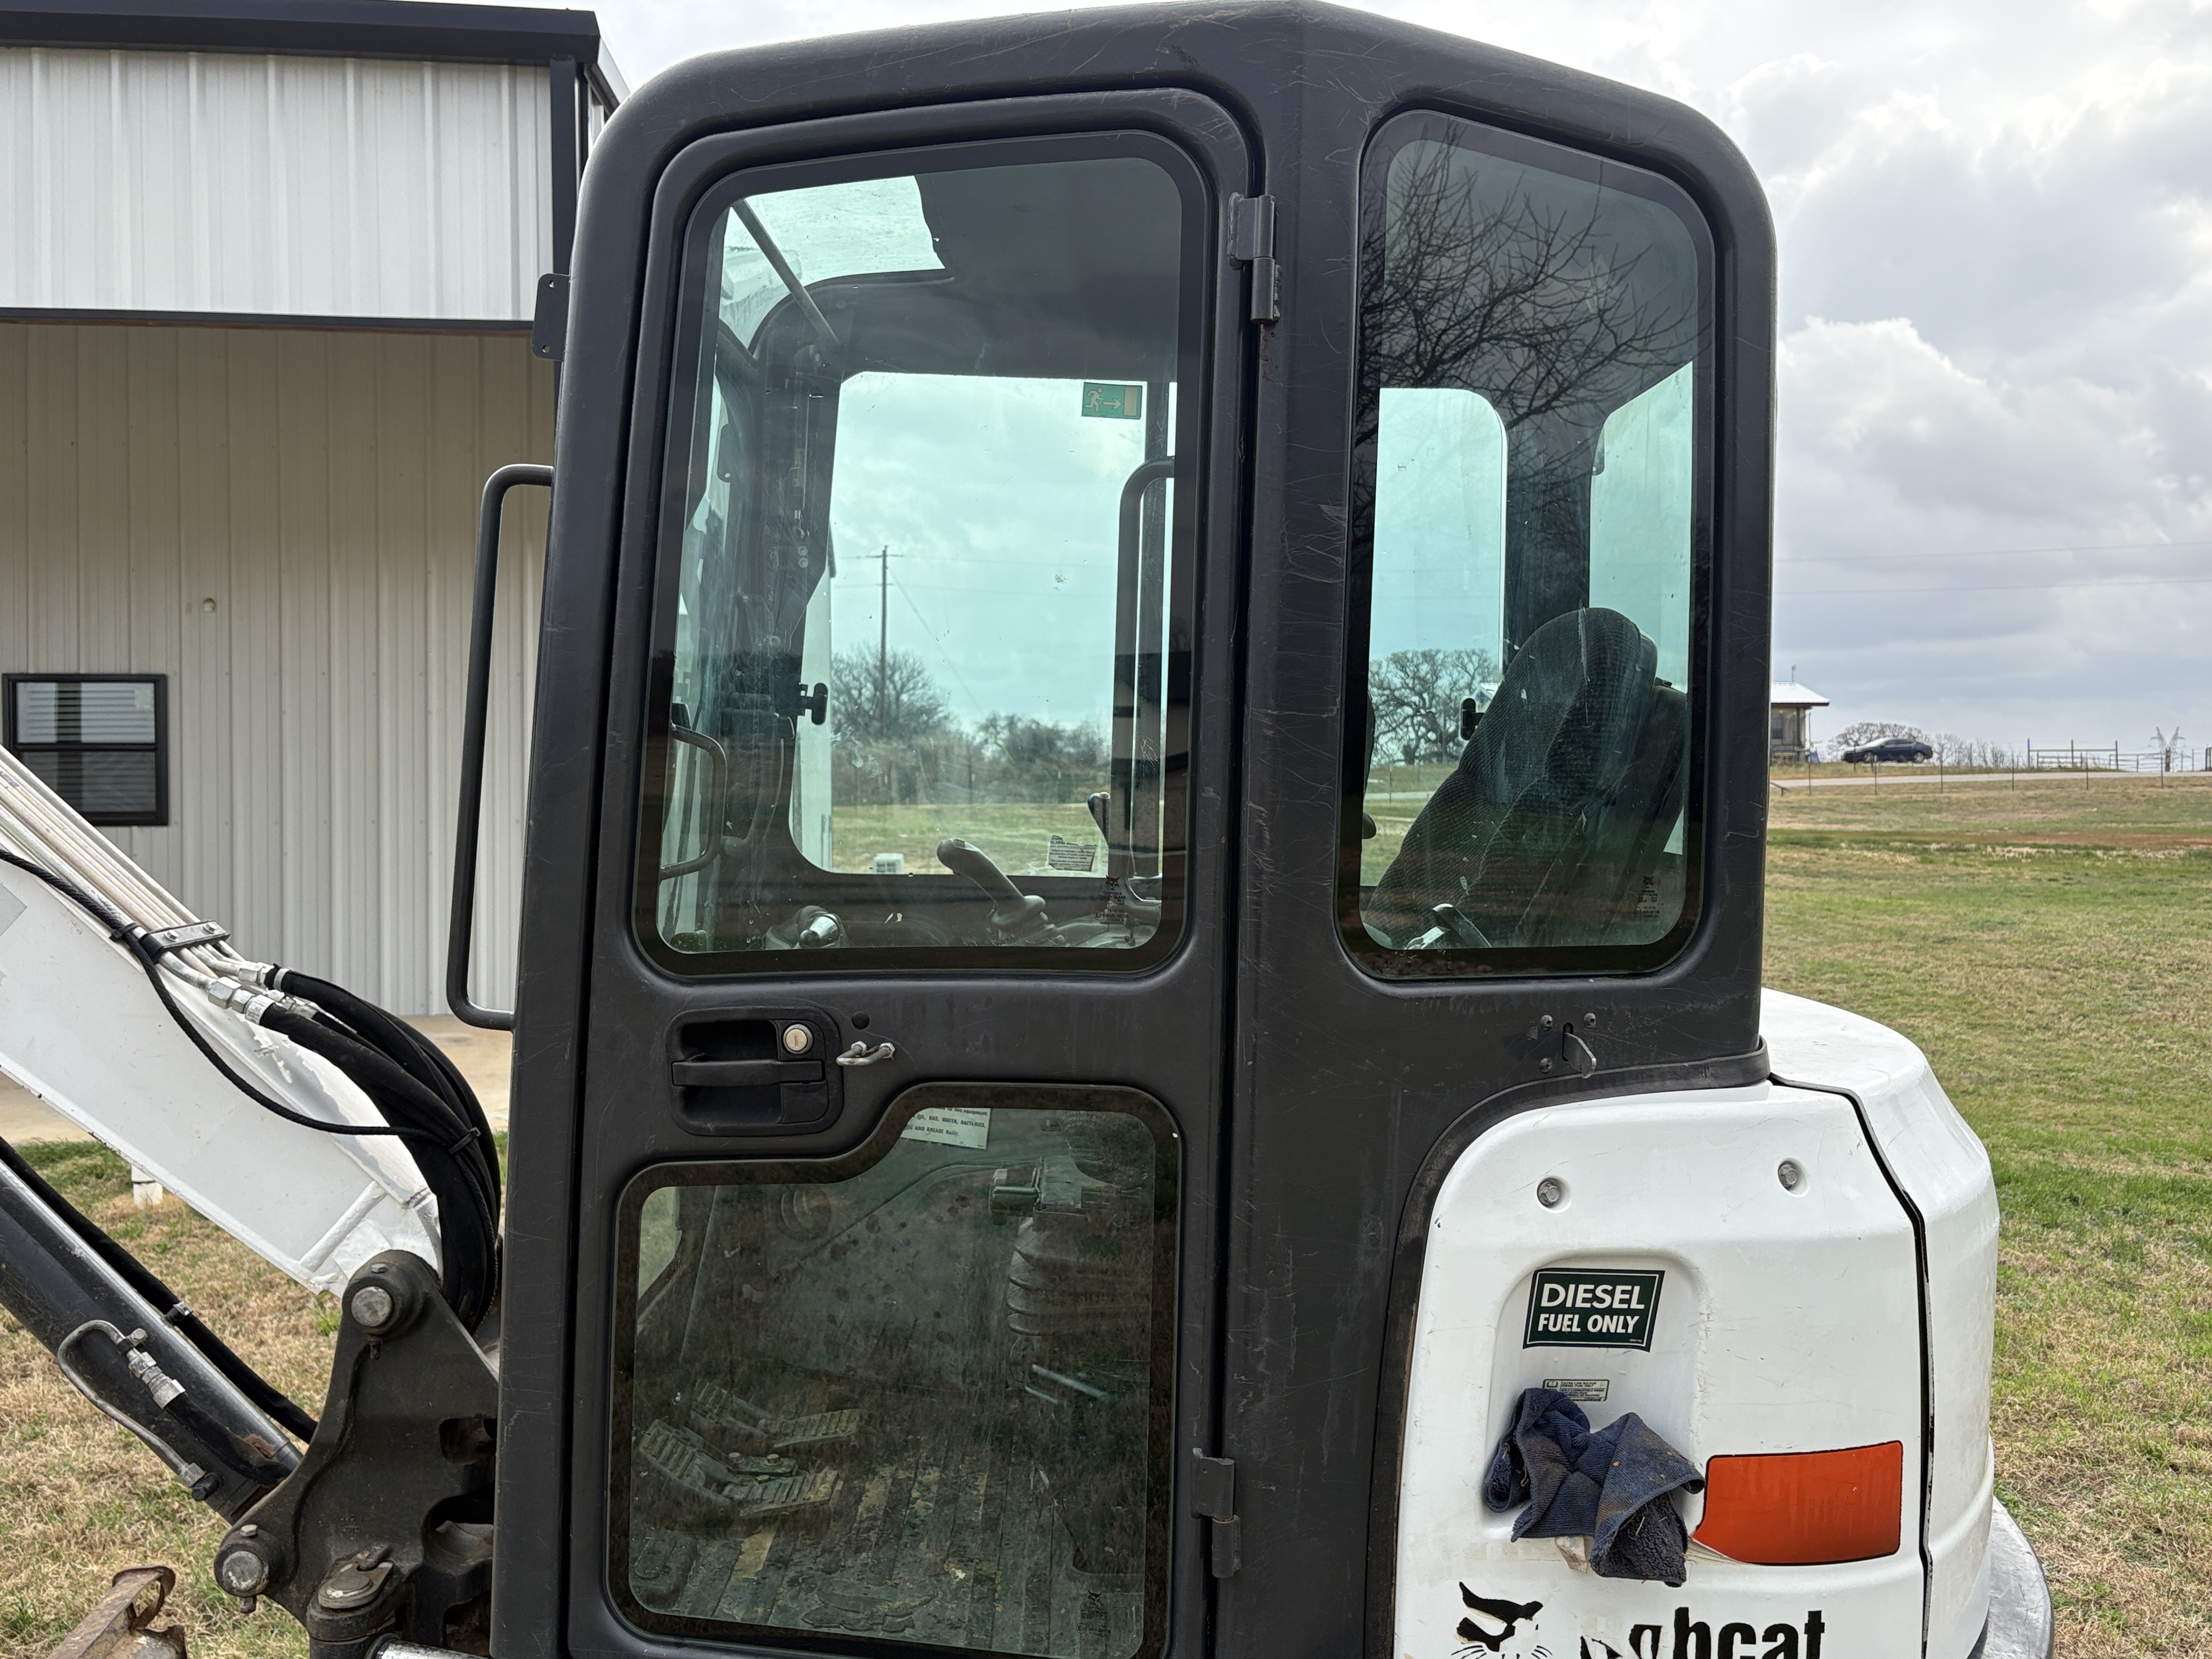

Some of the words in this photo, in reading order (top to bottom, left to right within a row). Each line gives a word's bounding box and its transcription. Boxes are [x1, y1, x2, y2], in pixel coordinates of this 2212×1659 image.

[1541, 1284, 1645, 1310] DIESEL
[1538, 1313, 1581, 1332] FUEL
[1587, 1314, 1640, 1334] ONLY
